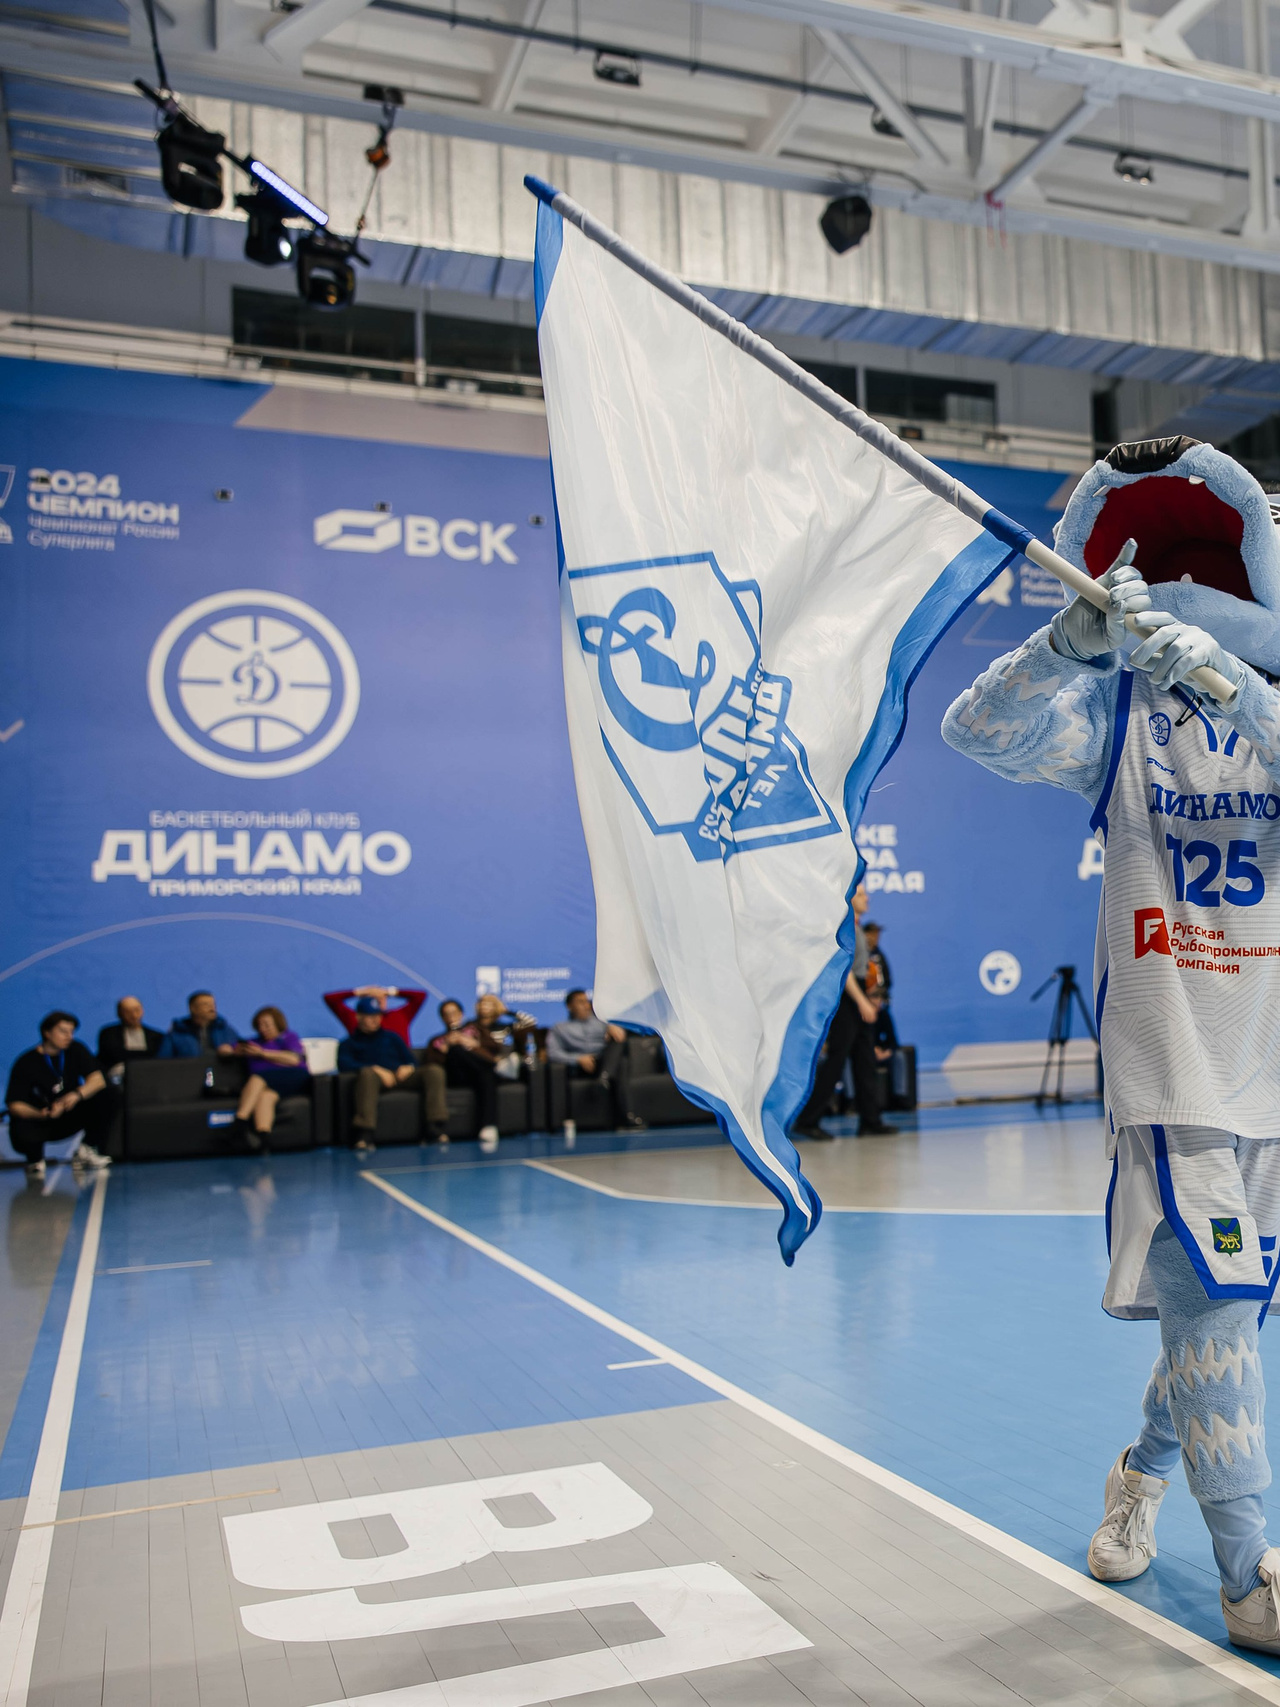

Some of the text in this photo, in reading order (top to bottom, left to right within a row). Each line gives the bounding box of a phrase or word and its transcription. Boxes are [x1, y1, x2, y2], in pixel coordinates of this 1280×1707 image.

[27, 468, 121, 498] 2024
[27, 493, 179, 525] ЧЕМПИОН
[404, 514, 518, 565] ВСК
[149, 809, 312, 829] БАСКЕТБОЛЬНЫЙ
[91, 829, 412, 882] ДИНАМО
[865, 870, 925, 894] РАЯ
[1166, 832, 1266, 908] 125
[149, 876, 362, 896] ПРИМОРСКИЙ КРАЙ
[1172, 921, 1225, 941] Русская
[1174, 954, 1240, 975] омпания
